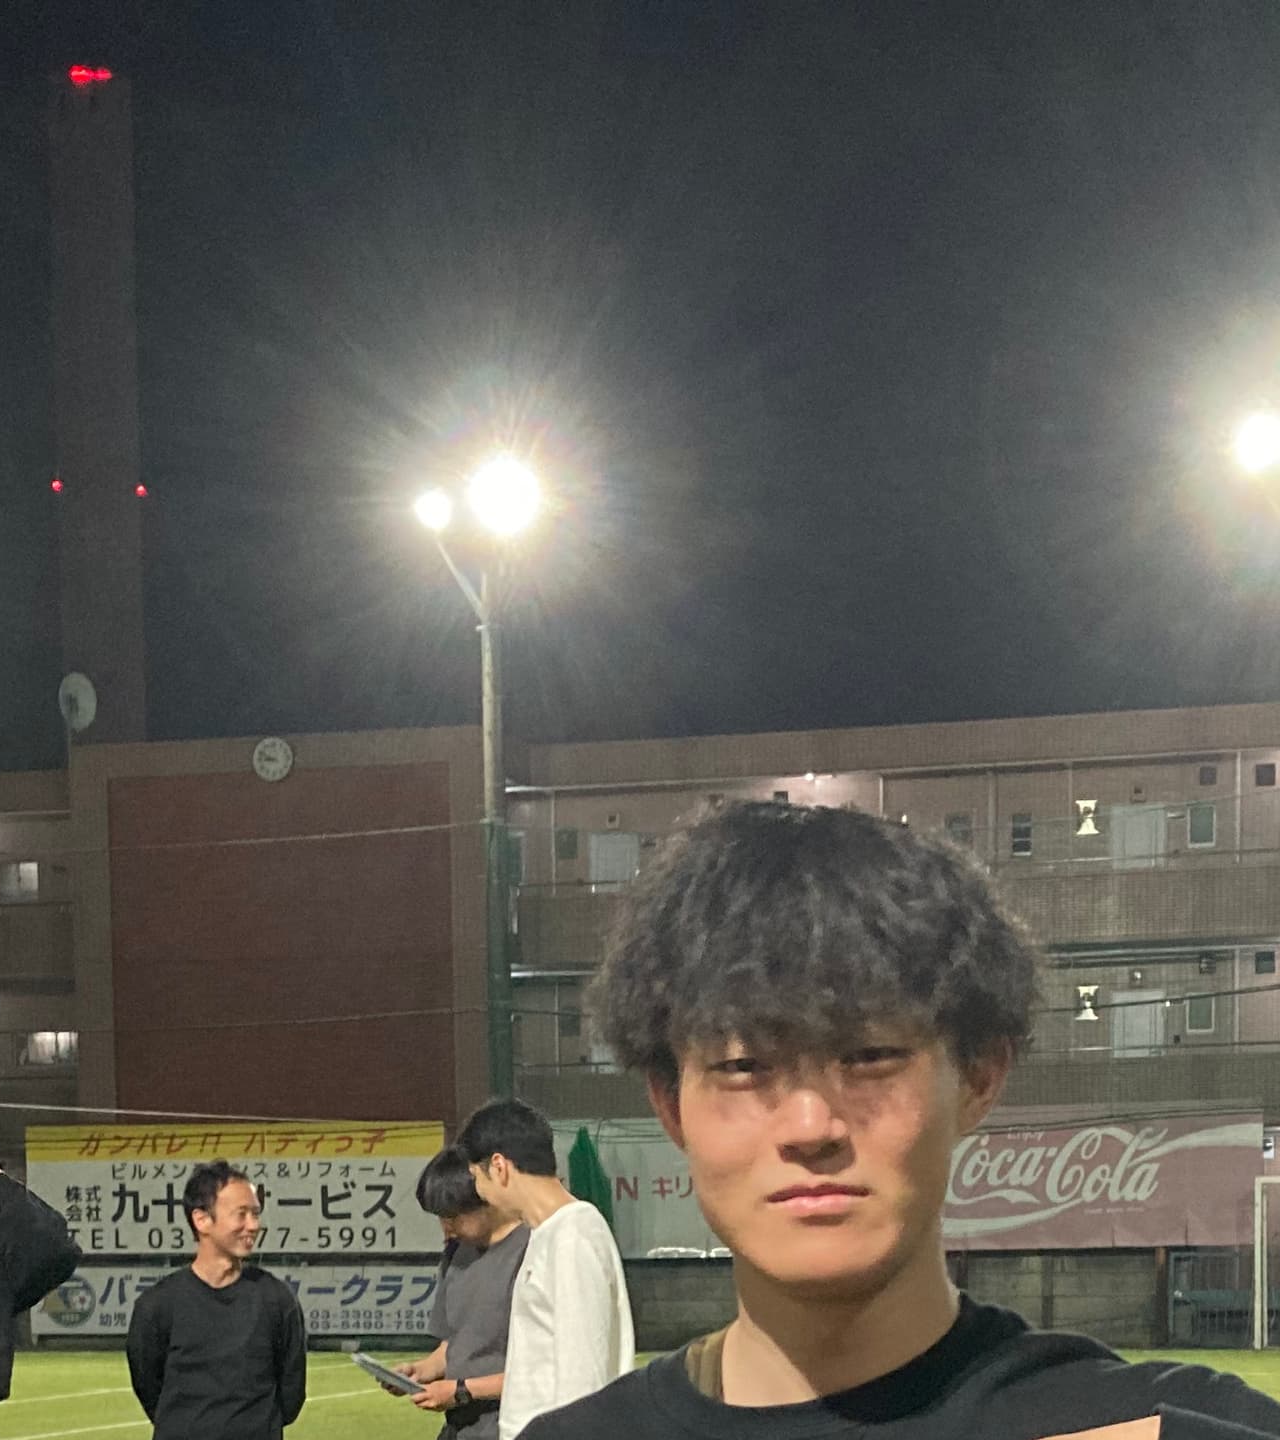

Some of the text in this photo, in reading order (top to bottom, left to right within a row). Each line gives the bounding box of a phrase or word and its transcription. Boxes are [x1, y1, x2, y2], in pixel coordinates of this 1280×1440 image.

[111, 1160, 397, 1181] ビルメンス&リフォーム
[943, 1125, 1169, 1207] Coca-Cola
[651, 1176, 694, 1199] キリ
[111, 1180, 397, 1224] 九十ービス
[66, 1225, 397, 1250] TEL 0377-5991
